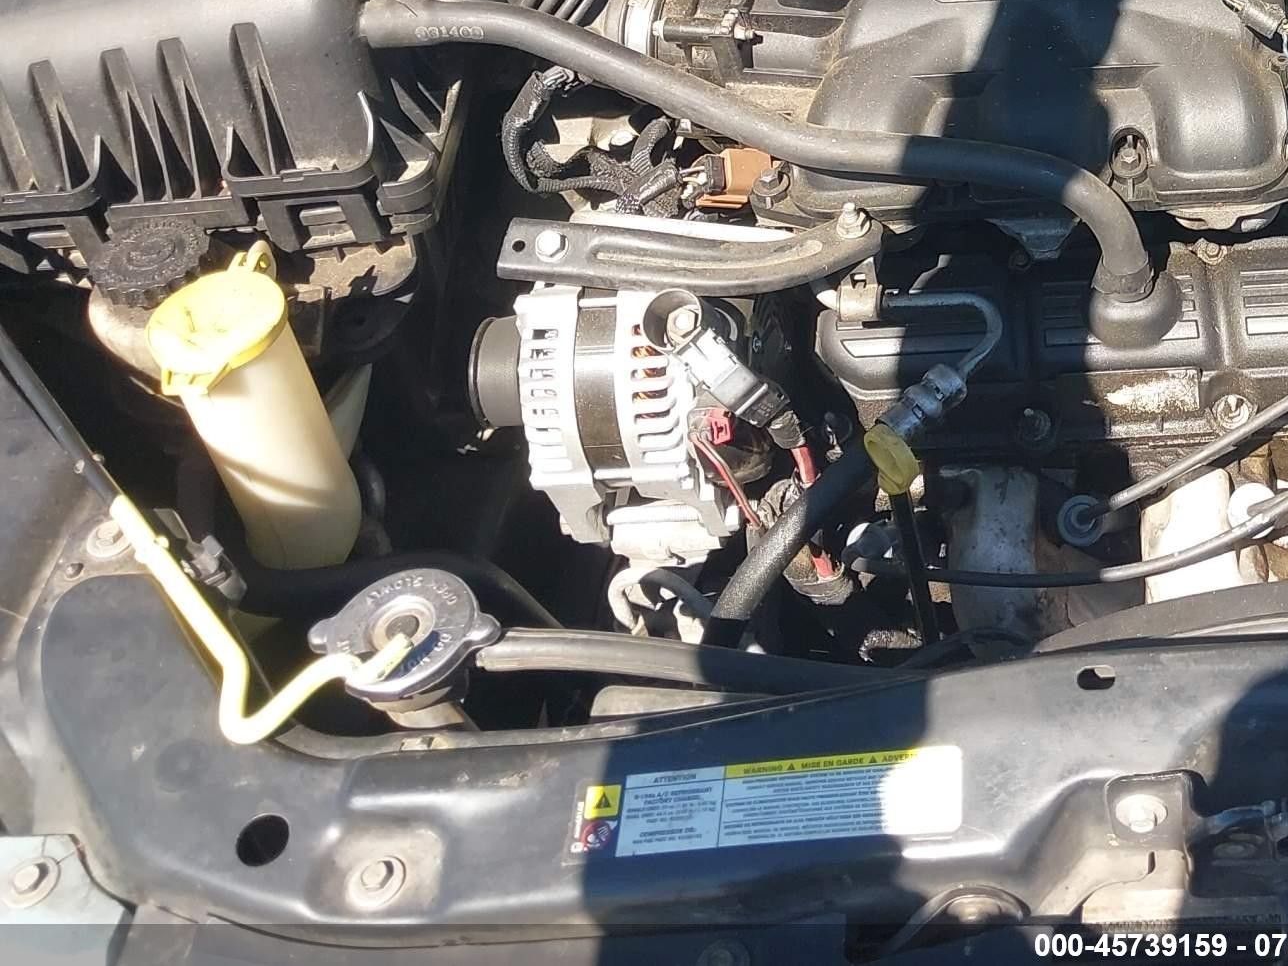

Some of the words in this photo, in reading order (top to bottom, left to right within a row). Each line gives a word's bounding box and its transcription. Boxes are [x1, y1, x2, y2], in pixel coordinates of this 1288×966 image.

[743, 764, 783, 775] WARNING
[801, 760, 823, 769] MISE
[823, 759, 834, 767] EN
[836, 757, 864, 766] GARDE
[652, 773, 697, 784] ATTENTION
